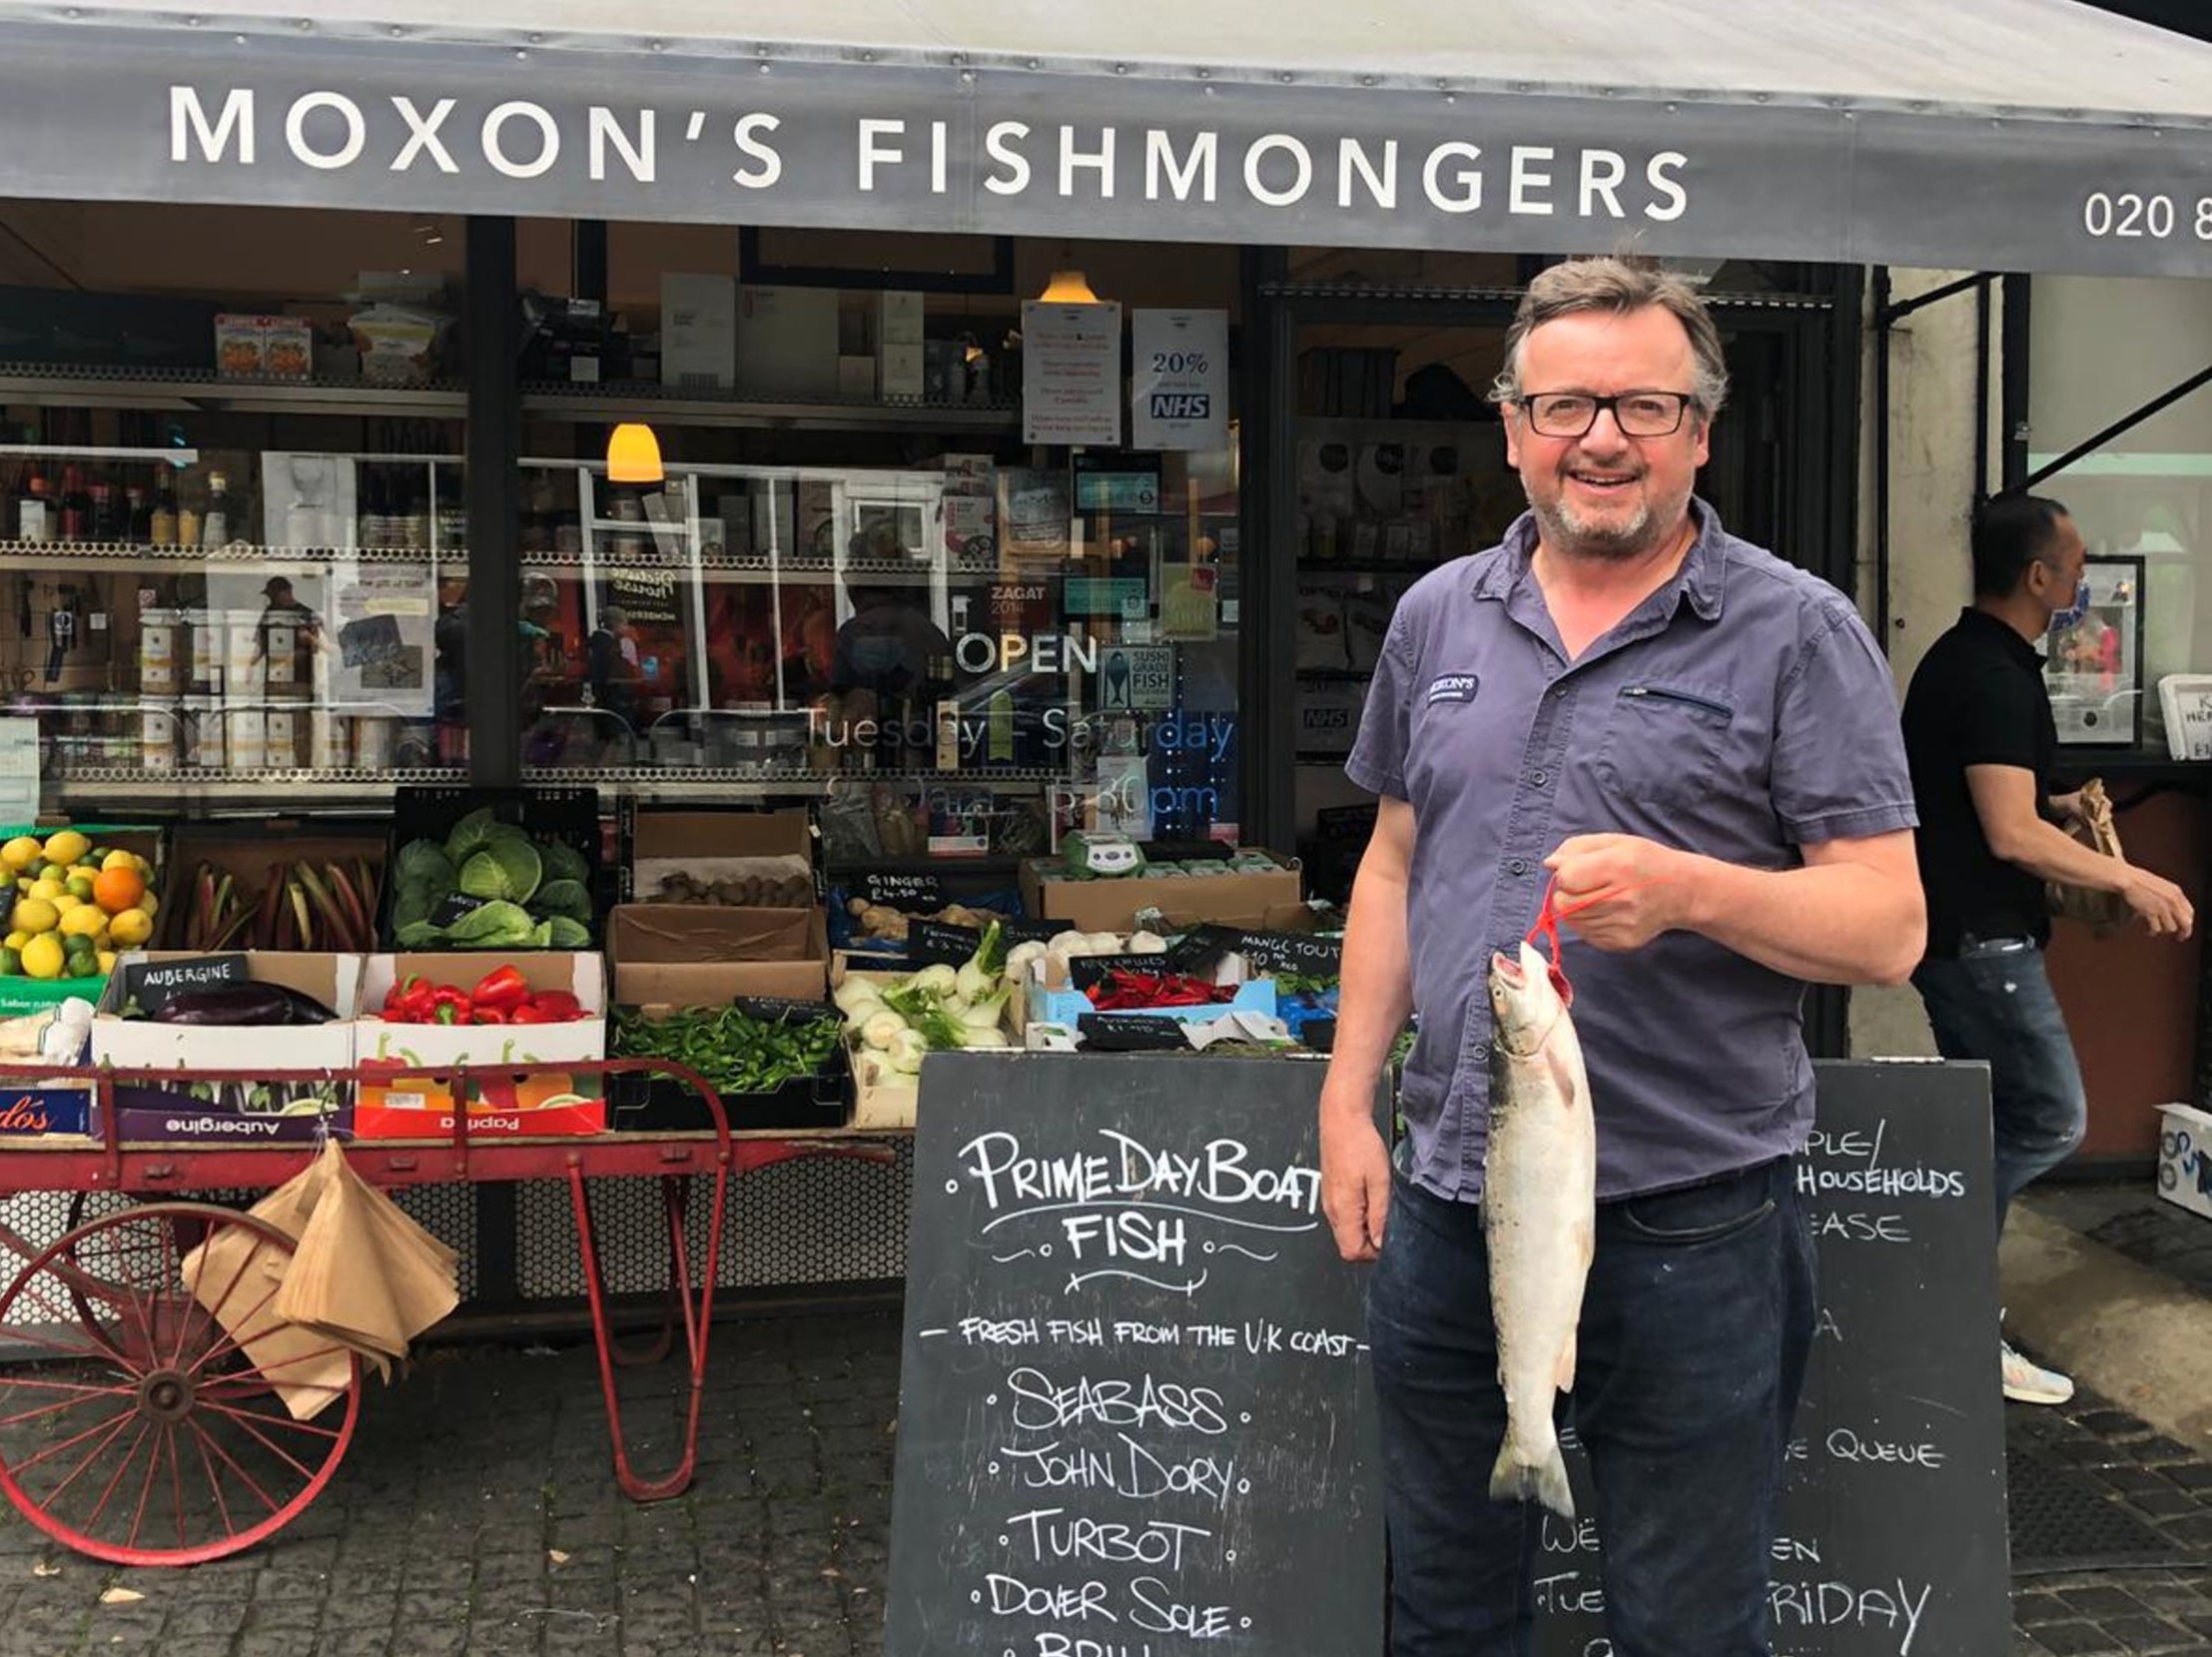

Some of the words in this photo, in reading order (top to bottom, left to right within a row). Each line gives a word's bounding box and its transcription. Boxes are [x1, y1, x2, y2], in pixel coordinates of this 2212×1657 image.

[170, 85, 782, 188] MOXON'S
[858, 119, 1688, 222] FISHMONGERS
[2084, 193, 2174, 238] 020
[1152, 353, 1208, 375] 20%
[1152, 396, 1207, 417] NHS
[991, 586, 1046, 599] ZAGAT
[955, 633, 1098, 675] OPEN
[1132, 651, 1170, 661] SUSHI
[1132, 663, 1169, 672] GRADE
[1132, 673, 1170, 687] FISH
[807, 707, 987, 760] Tuesday
[1042, 707, 1233, 761] Saturday
[867, 875, 940, 888] GINGER
[1296, 941, 1340, 959] TOUT
[144, 964, 232, 987] AUBERGINE
[0, 1096, 48, 1130] dós
[166, 1119, 281, 1136] Aubergine
[439, 1116, 520, 1132] Papria
[1799, 1119, 1886, 1171] PLE/
[958, 1132, 1110, 1209] PRIME
[1098, 1129, 1199, 1198] DAY
[1198, 1140, 1323, 1215] BOAT
[1798, 1166, 1965, 1197] HOUSEHOLDS
[1063, 1211, 1186, 1265] FISH
[1810, 1212, 1912, 1243] EASE
[959, 1316, 1039, 1346] FRESH
[1047, 1319, 1105, 1346] FISH
[1114, 1321, 1179, 1346] FROM
[1187, 1324, 1237, 1346] THE
[1007, 1367, 1227, 1433] SEABASS
[1827, 1428, 1947, 1469] QUEUE
[1001, 1441, 1115, 1488] JOHN
[1117, 1432, 1233, 1511] DORY
[1007, 1508, 1211, 1571] TURBOT
[1770, 1537, 1822, 1563] EN
[986, 1573, 1117, 1622] DOVER
[1128, 1576, 1231, 1638] SOLE
[1534, 1571, 1606, 1614] TUE
